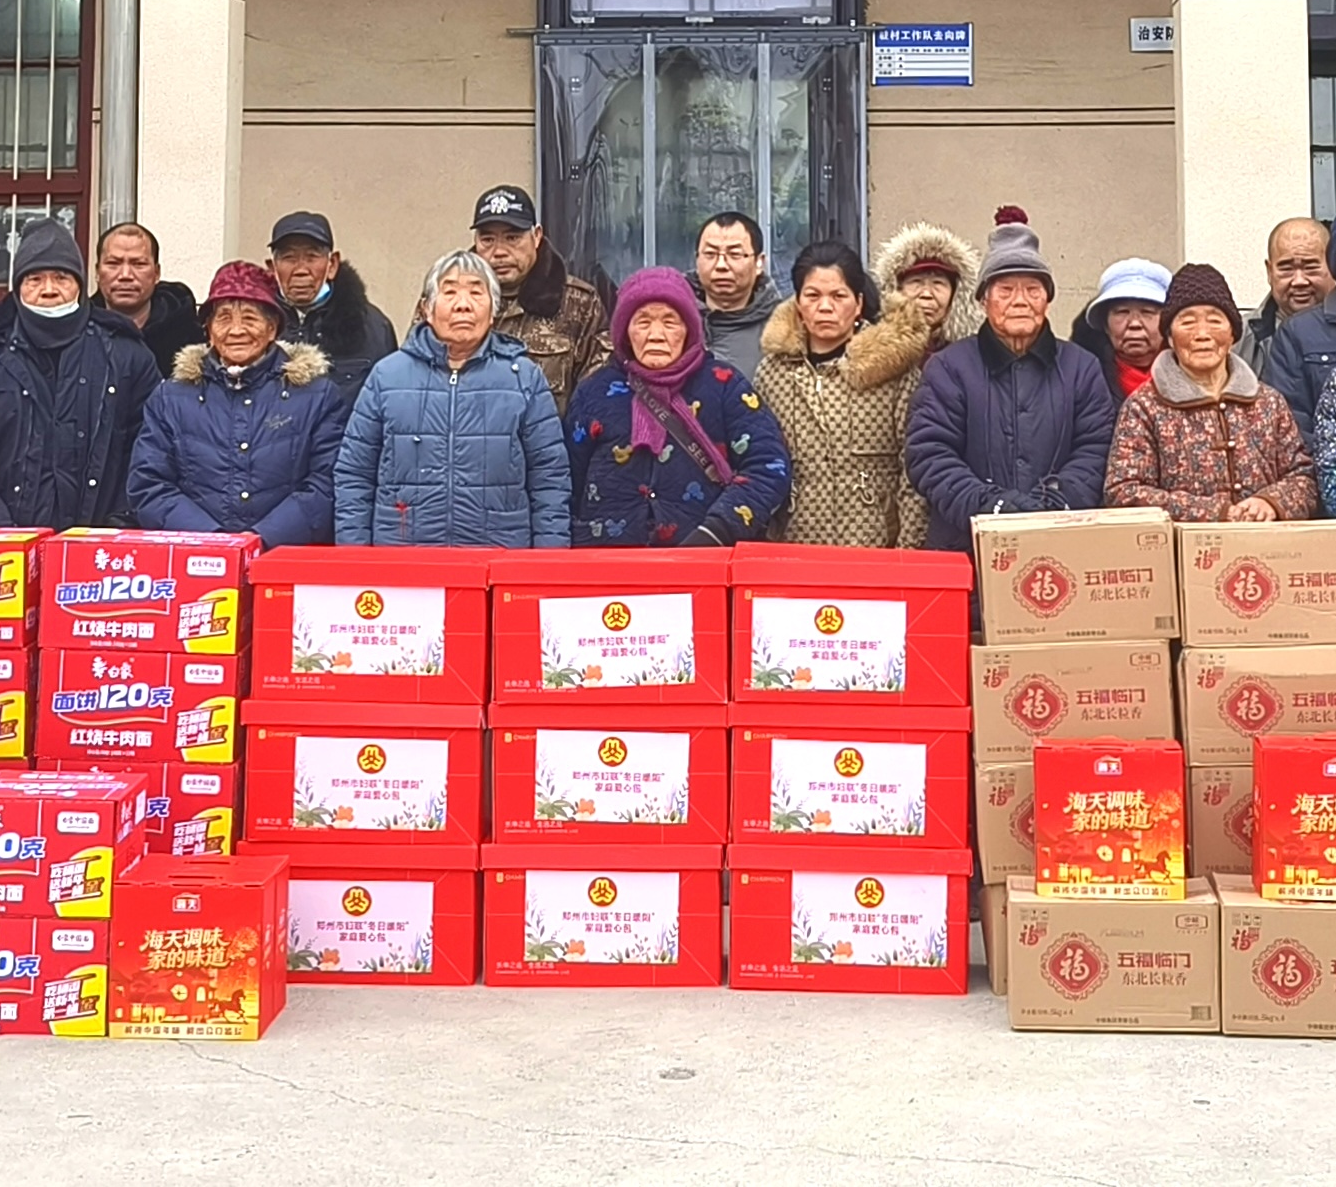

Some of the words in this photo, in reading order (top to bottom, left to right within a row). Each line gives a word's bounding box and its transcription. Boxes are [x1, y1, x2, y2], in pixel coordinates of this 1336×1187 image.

[1030, 570, 1059, 600] 福
[1084, 568, 1153, 585] 五福临门
[1233, 570, 1262, 600] 福
[56, 575, 176, 604] 面饼120克
[1089, 586, 1151, 602] 东北长粒香
[72, 619, 155, 639] 红烧牛肉面
[52, 683, 174, 713] 面饼120克
[1022, 688, 1050, 719] 福
[1076, 688, 1145, 705] 五福临门
[1236, 689, 1265, 720] 福
[1081, 706, 1142, 721] 东北长粒香
[70, 728, 153, 748] 红烧牛肉面
[1063, 790, 1153, 816] 海天调味
[1065, 809, 1154, 834] 家的味道
[139, 927, 230, 952] 海天调味
[142, 947, 231, 971] 家的味道
[1059, 947, 1090, 981] 福
[1117, 952, 1191, 969] 五福临门
[1272, 954, 1302, 987] 福
[1122, 971, 1187, 987] 东北长粒香
